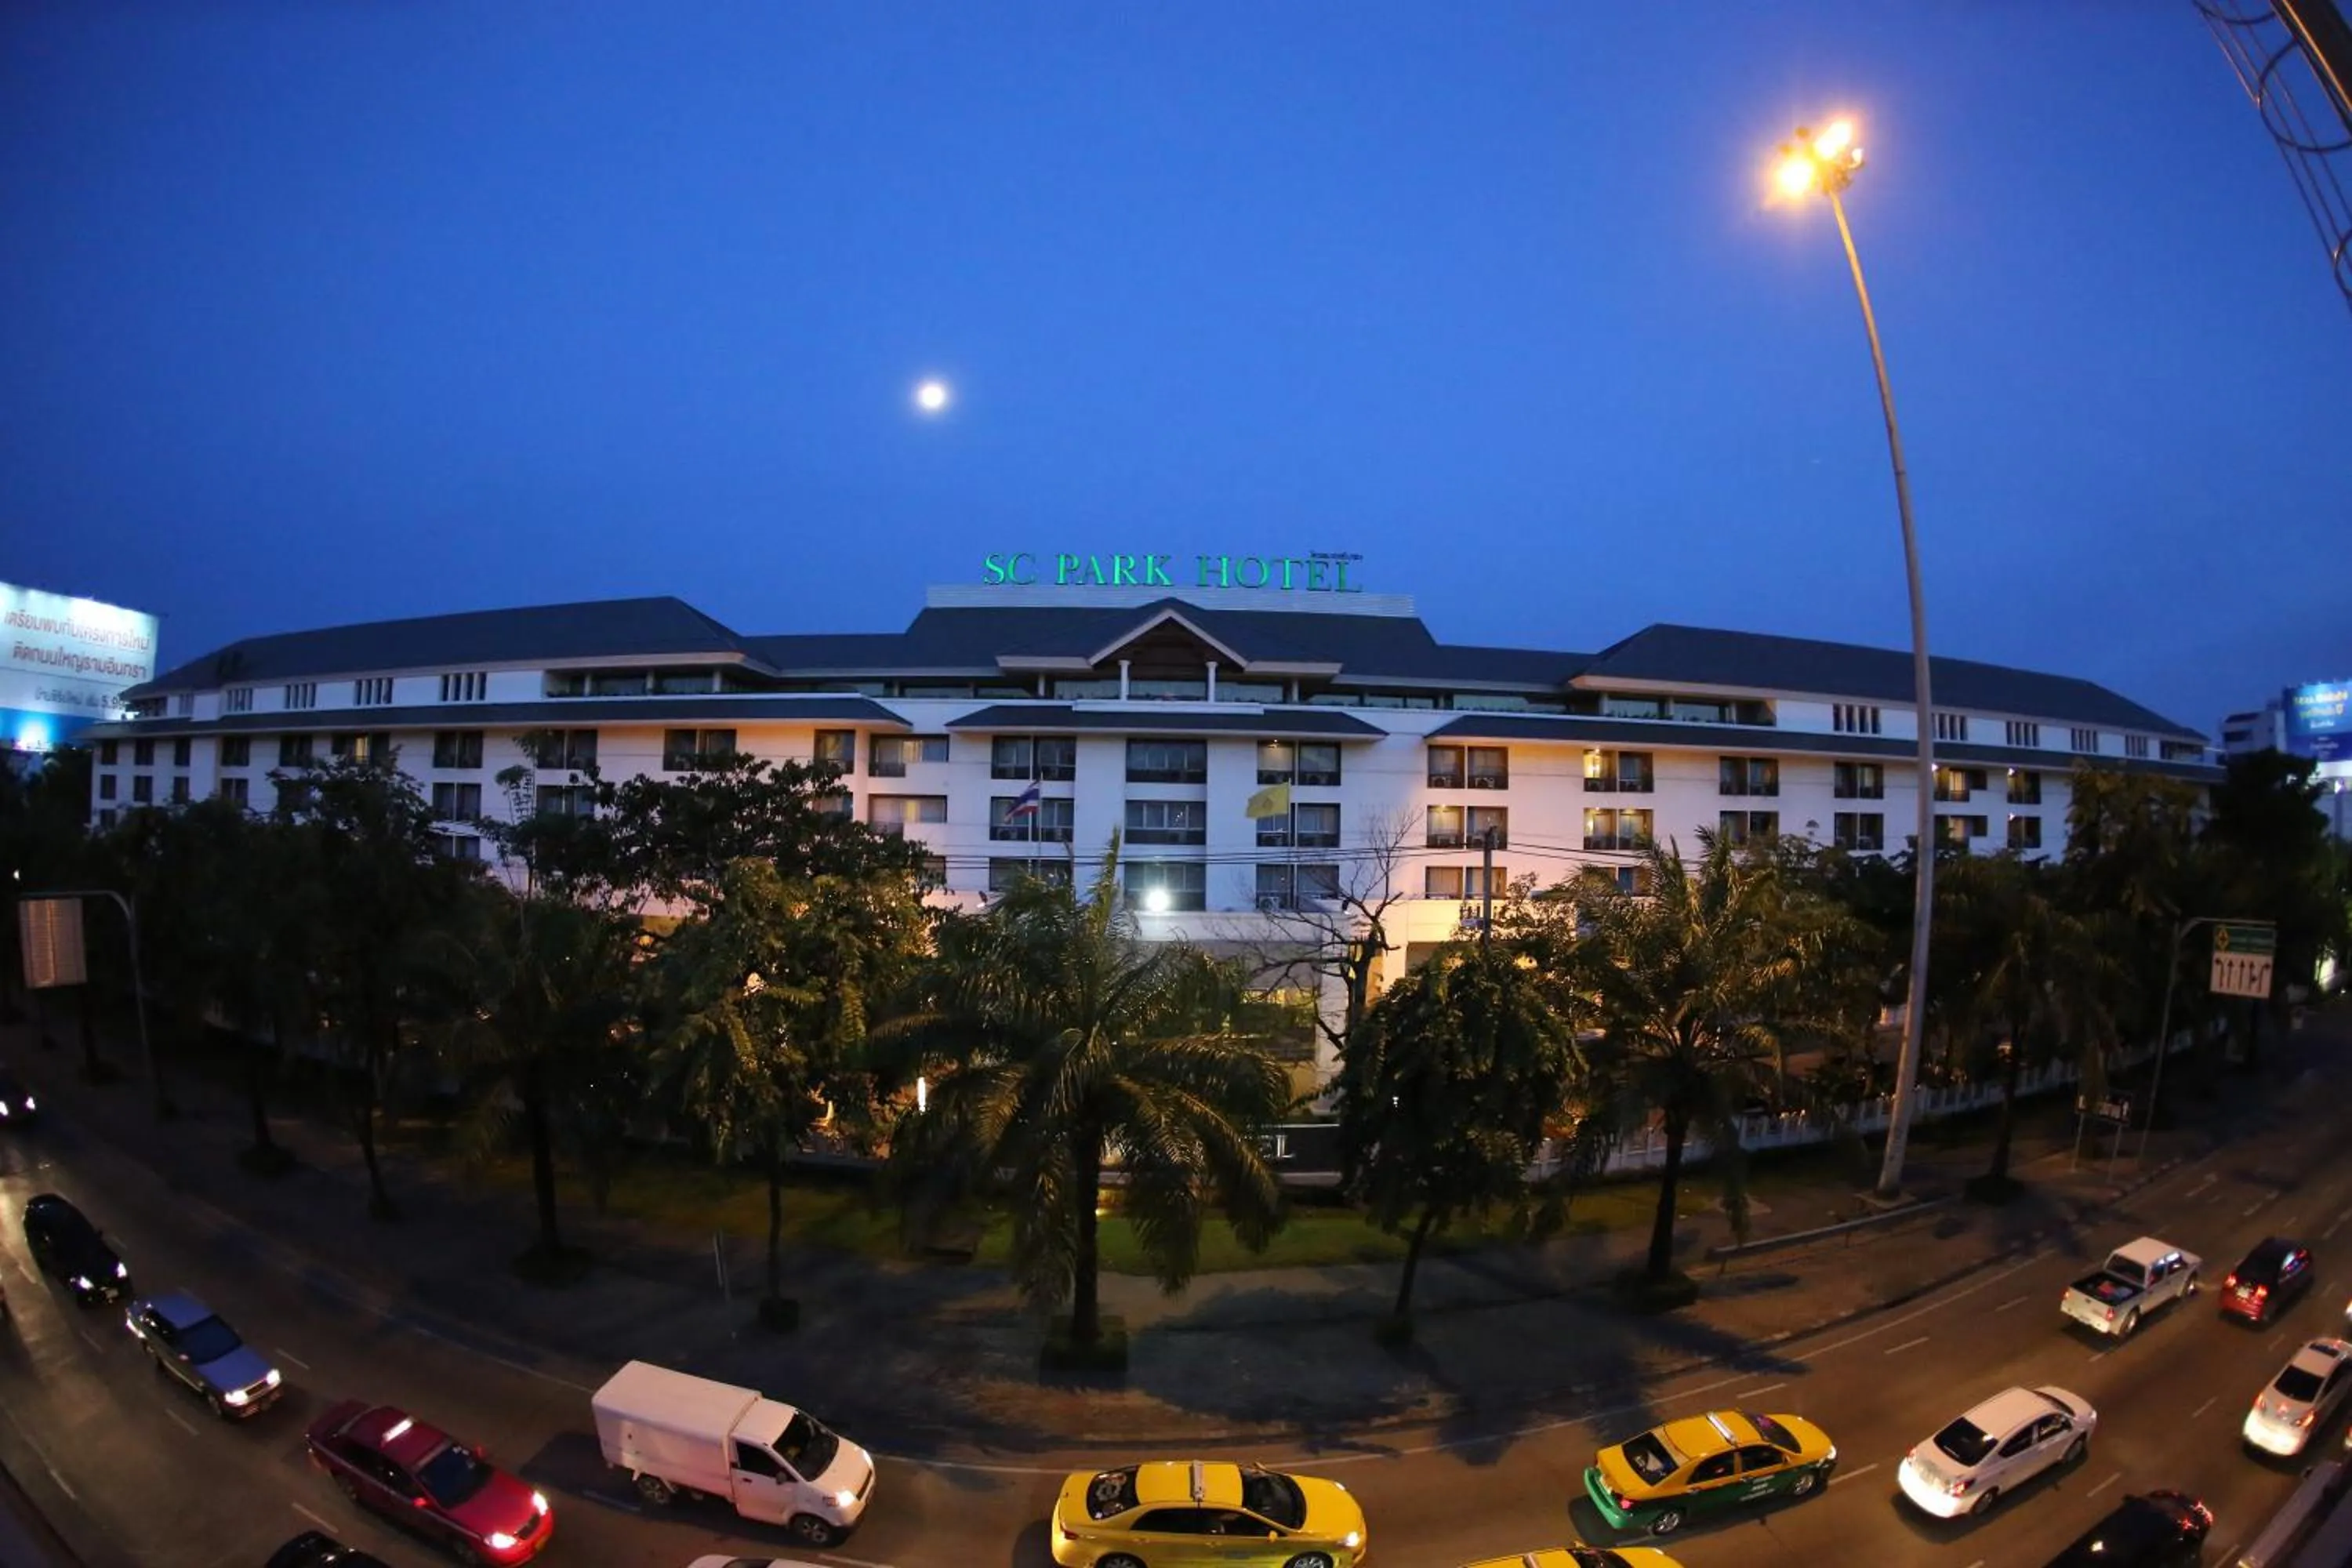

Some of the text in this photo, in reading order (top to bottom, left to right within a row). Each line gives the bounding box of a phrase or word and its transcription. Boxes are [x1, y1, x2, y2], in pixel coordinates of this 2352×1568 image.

[984, 553, 1363, 593] SC PARK HOTEL
